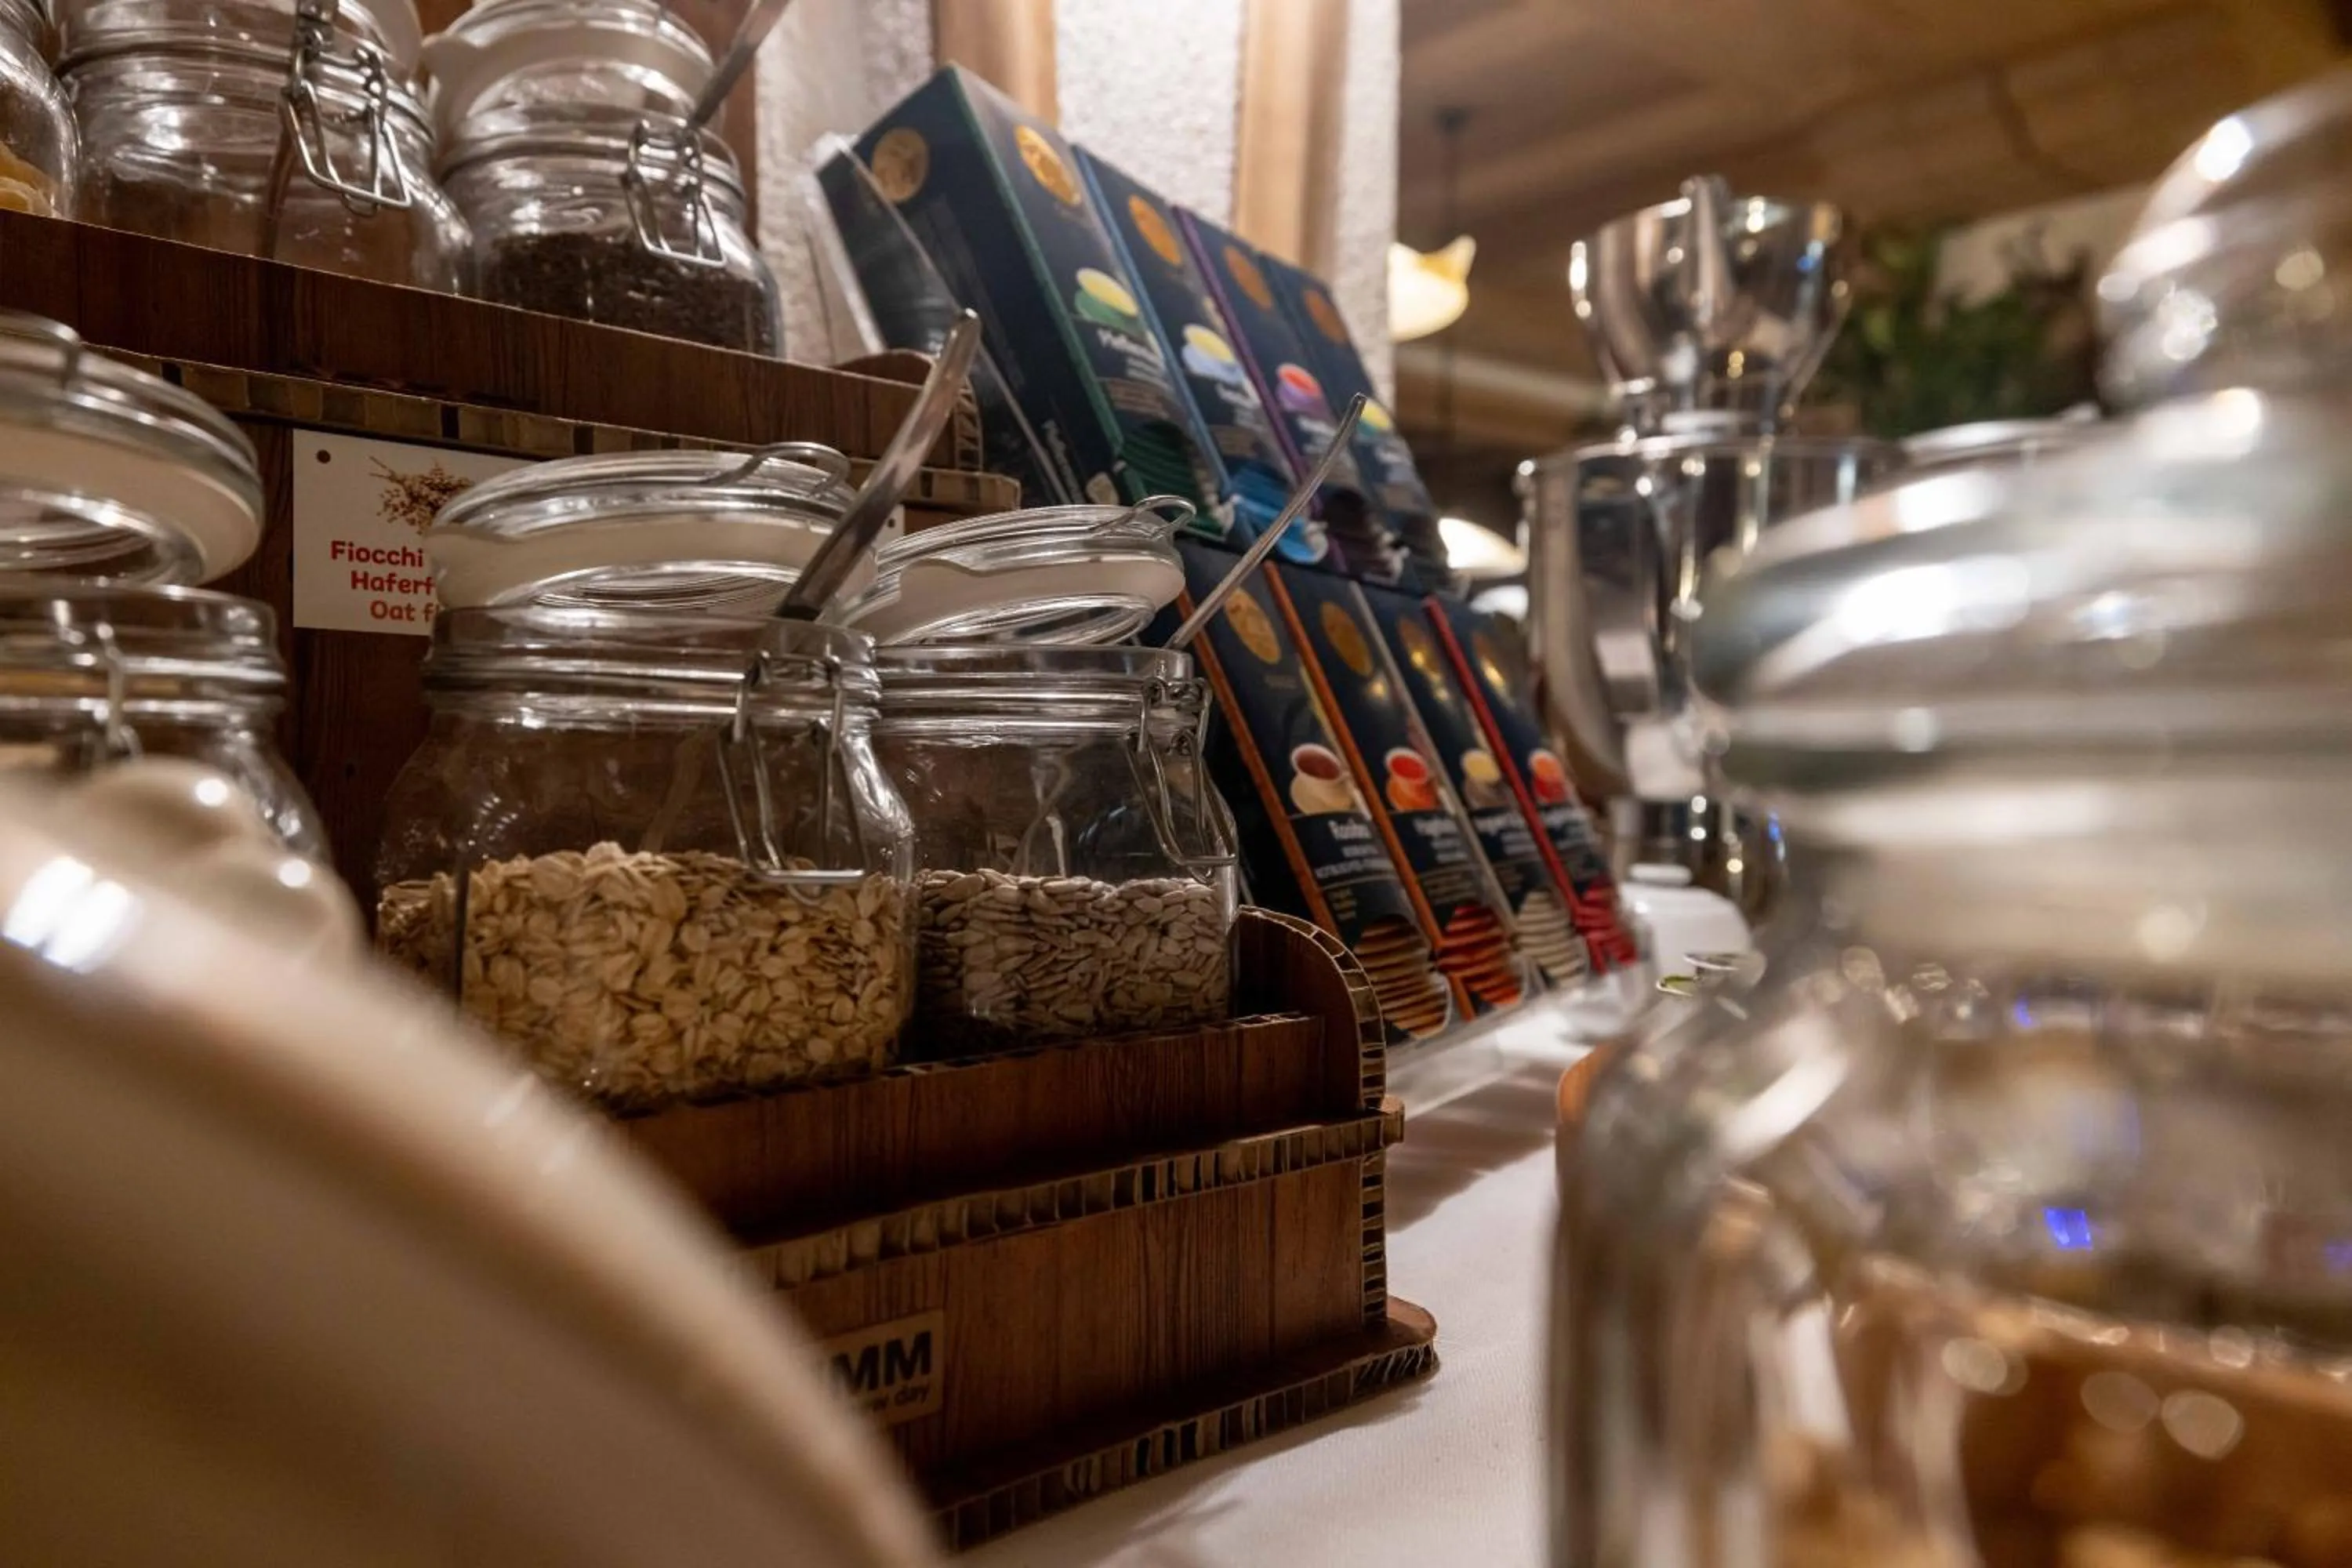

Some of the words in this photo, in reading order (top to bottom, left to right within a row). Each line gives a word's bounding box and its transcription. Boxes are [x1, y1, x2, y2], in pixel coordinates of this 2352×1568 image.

[330, 540, 423, 567] Fiocchi
[350, 570, 436, 595] Haferf
[370, 600, 416, 622] Oat
